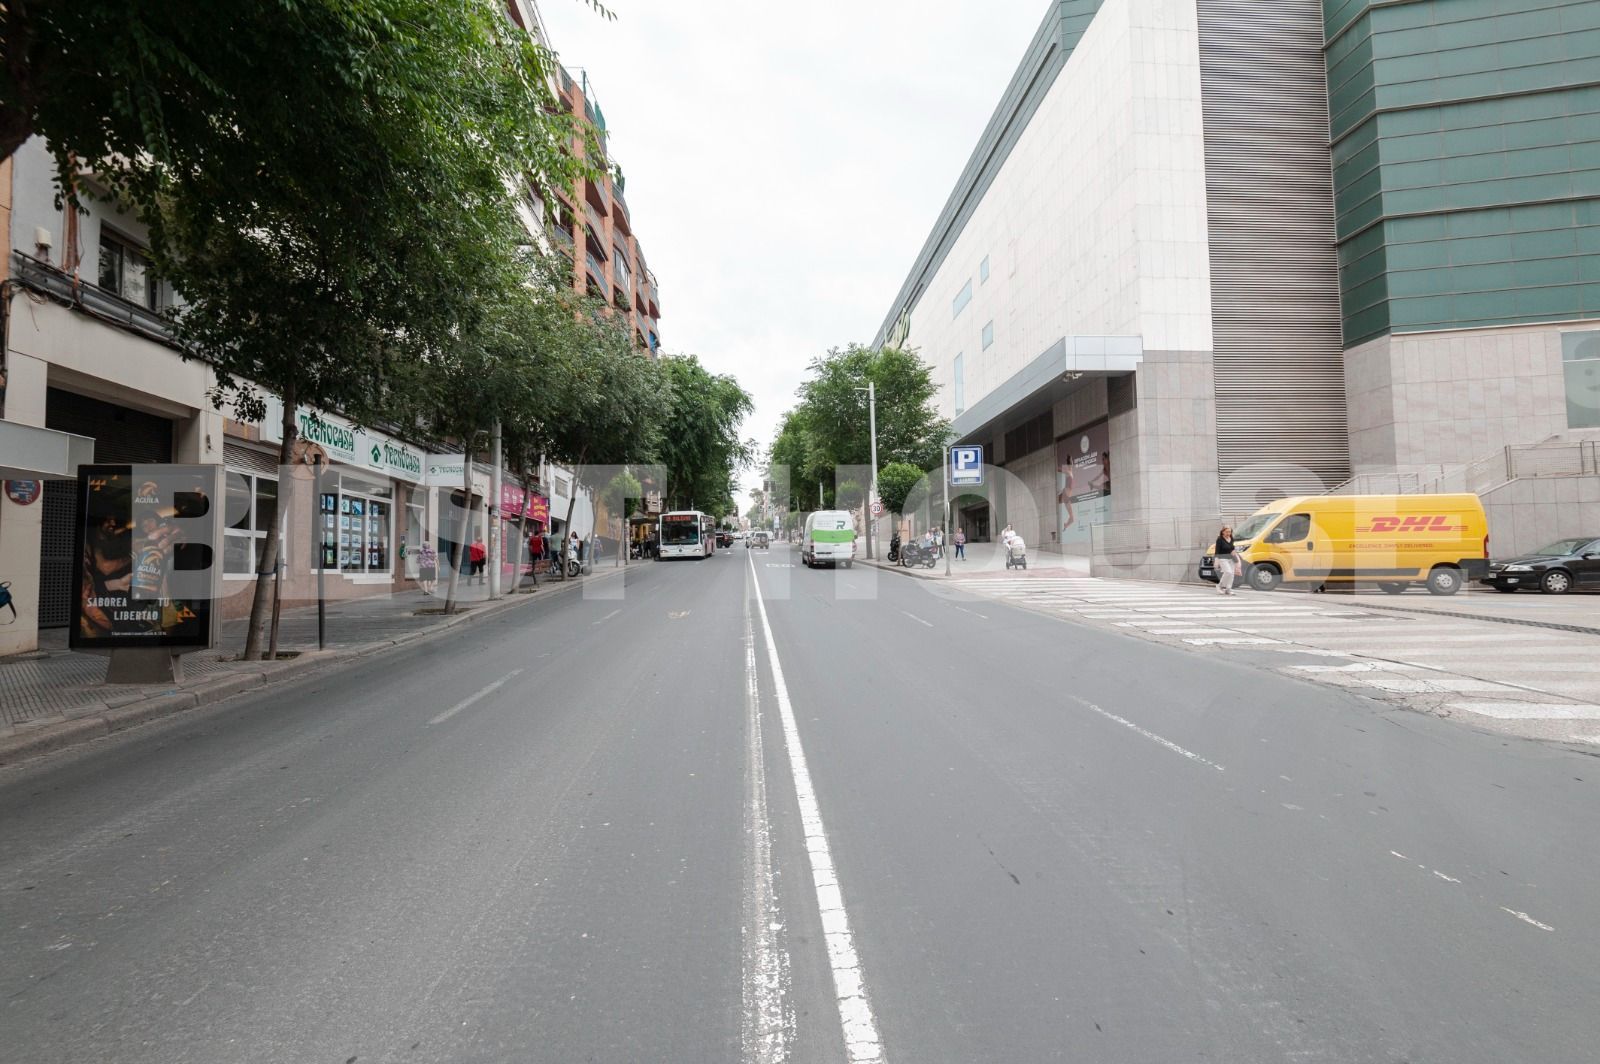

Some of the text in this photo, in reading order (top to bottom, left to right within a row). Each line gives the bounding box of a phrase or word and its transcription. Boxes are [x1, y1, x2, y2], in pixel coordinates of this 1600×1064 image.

[300, 414, 353, 452] TECNOCASA
[384, 443, 421, 474] TECNOCASA
[957, 450, 975, 470] P
[836, 520, 846, 529] R
[1371, 516, 1453, 532] DHL
[86, 597, 170, 607] SABOREA TU
[113, 611, 159, 621] LIBERTAD
